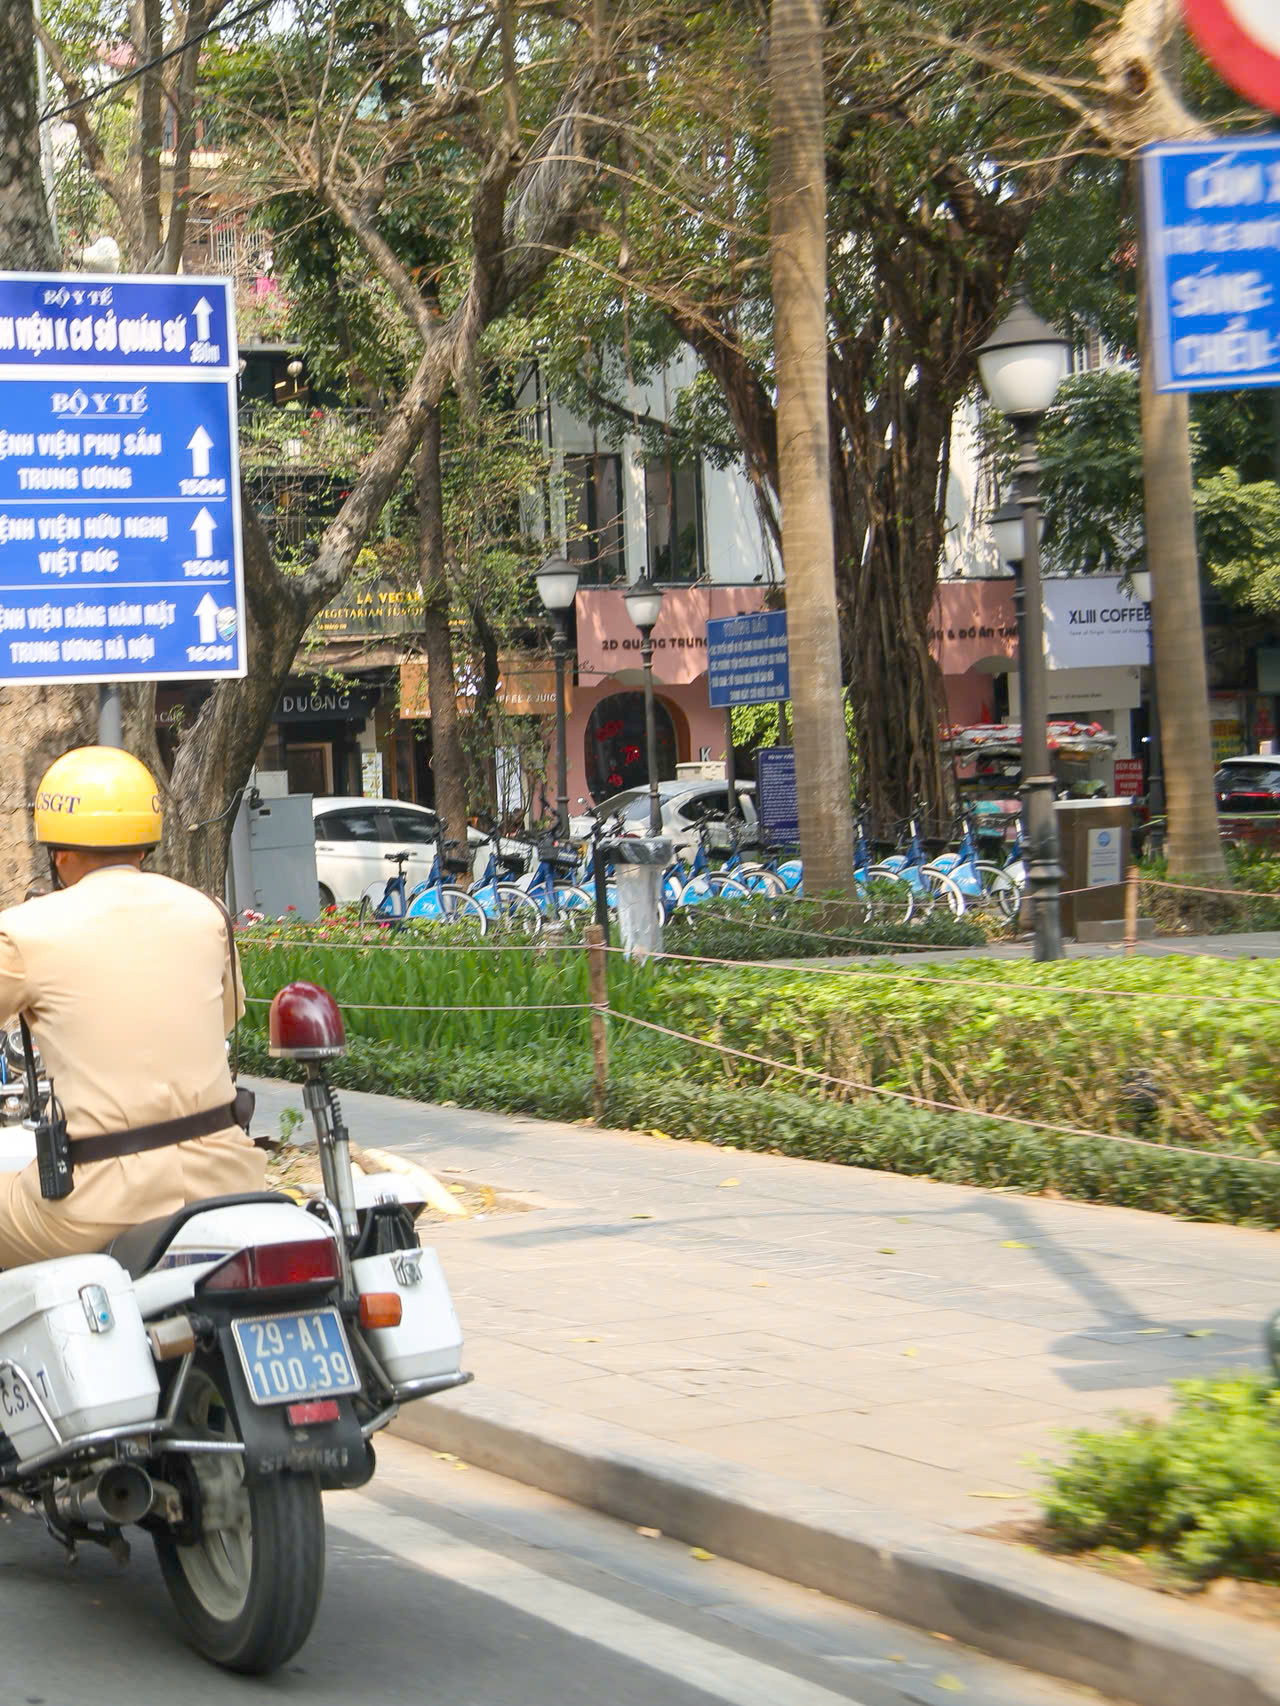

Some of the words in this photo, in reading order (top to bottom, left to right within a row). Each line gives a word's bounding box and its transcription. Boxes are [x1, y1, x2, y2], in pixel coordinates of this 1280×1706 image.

[43, 286, 69, 308] BỘ
[71, 290, 86, 305] Y
[87, 286, 113, 307] TẾ
[15, 311, 55, 357] VIỆN
[55, 318, 69, 350] K
[119, 313, 162, 355] QUÁN
[163, 313, 187, 352] SỨ
[50, 388, 89, 416] BỘ
[90, 393, 111, 413] Y
[113, 385, 149, 413] TẾ
[37, 429, 80, 460] VIỆN
[83, 432, 120, 460] PHỤ
[123, 426, 162, 456] SẢN
[17, 466, 79, 490] TRUNG
[81, 465, 132, 489] ƯƠNG
[37, 513, 81, 544] VIỆN
[84, 512, 121, 539] HỮU
[124, 515, 168, 542] NGHỊ
[38, 546, 78, 578] VIỆT
[80, 546, 119, 573] ĐỨC
[356, 592, 372, 604] LA
[27, 602, 63, 633] VIỆN
[64, 601, 107, 628] RĂNG
[107, 600, 143, 627] HÀM
[144, 600, 176, 629] MẶT
[1069, 609, 1096, 624] XLIII
[1100, 608, 1152, 622] COFFEE
[9, 640, 60, 664] TRUNG
[61, 638, 104, 662] ƯƠNG
[104, 634, 127, 660] HÀ
[128, 633, 155, 663] NỘI
[602, 640, 618, 650] 2D
[282, 696, 351, 713] DUONG
[36, 792, 80, 814] CSGT
[250, 1315, 328, 1357] 29-A1
[254, 1352, 350, 1395] 100.39
